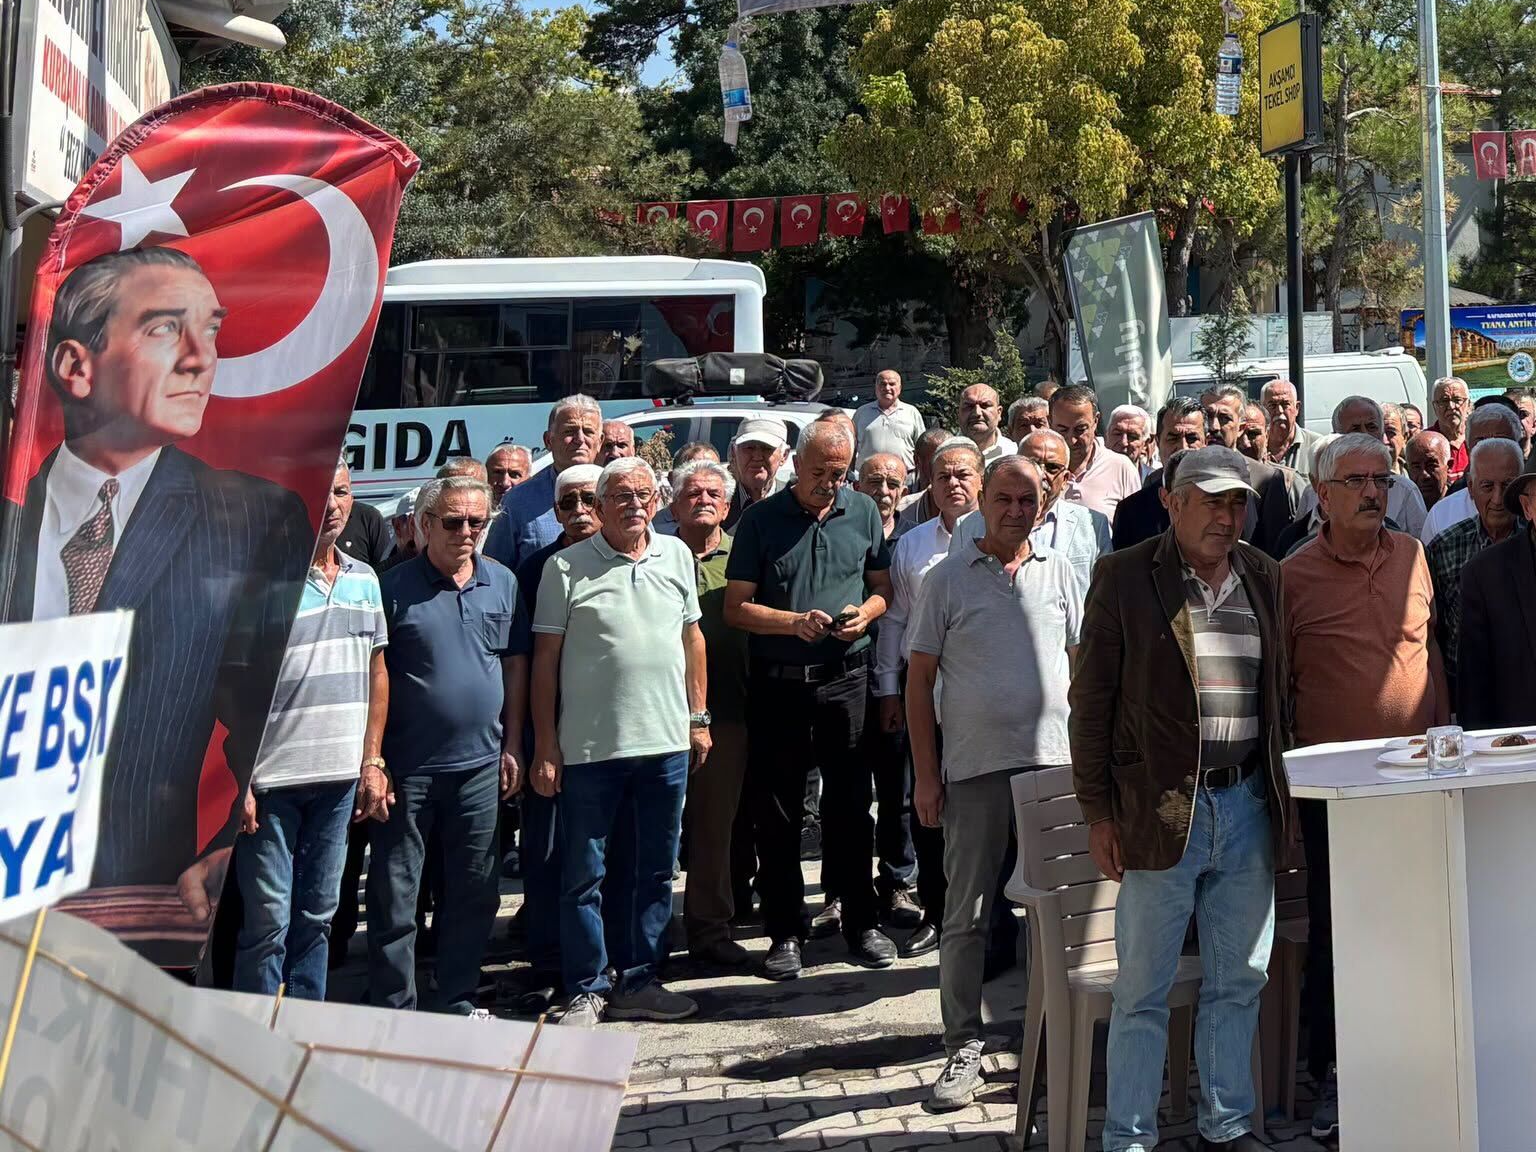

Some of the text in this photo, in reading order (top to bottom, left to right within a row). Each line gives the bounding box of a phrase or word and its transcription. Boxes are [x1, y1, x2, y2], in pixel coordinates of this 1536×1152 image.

[1269, 64, 1295, 89] AKŞAMCI
[1264, 83, 1301, 111] TEKEL SHOP
[1480, 320, 1506, 329] TYANA
[1508, 318, 1533, 328] ANTİK
[345, 419, 472, 471] GIDA
